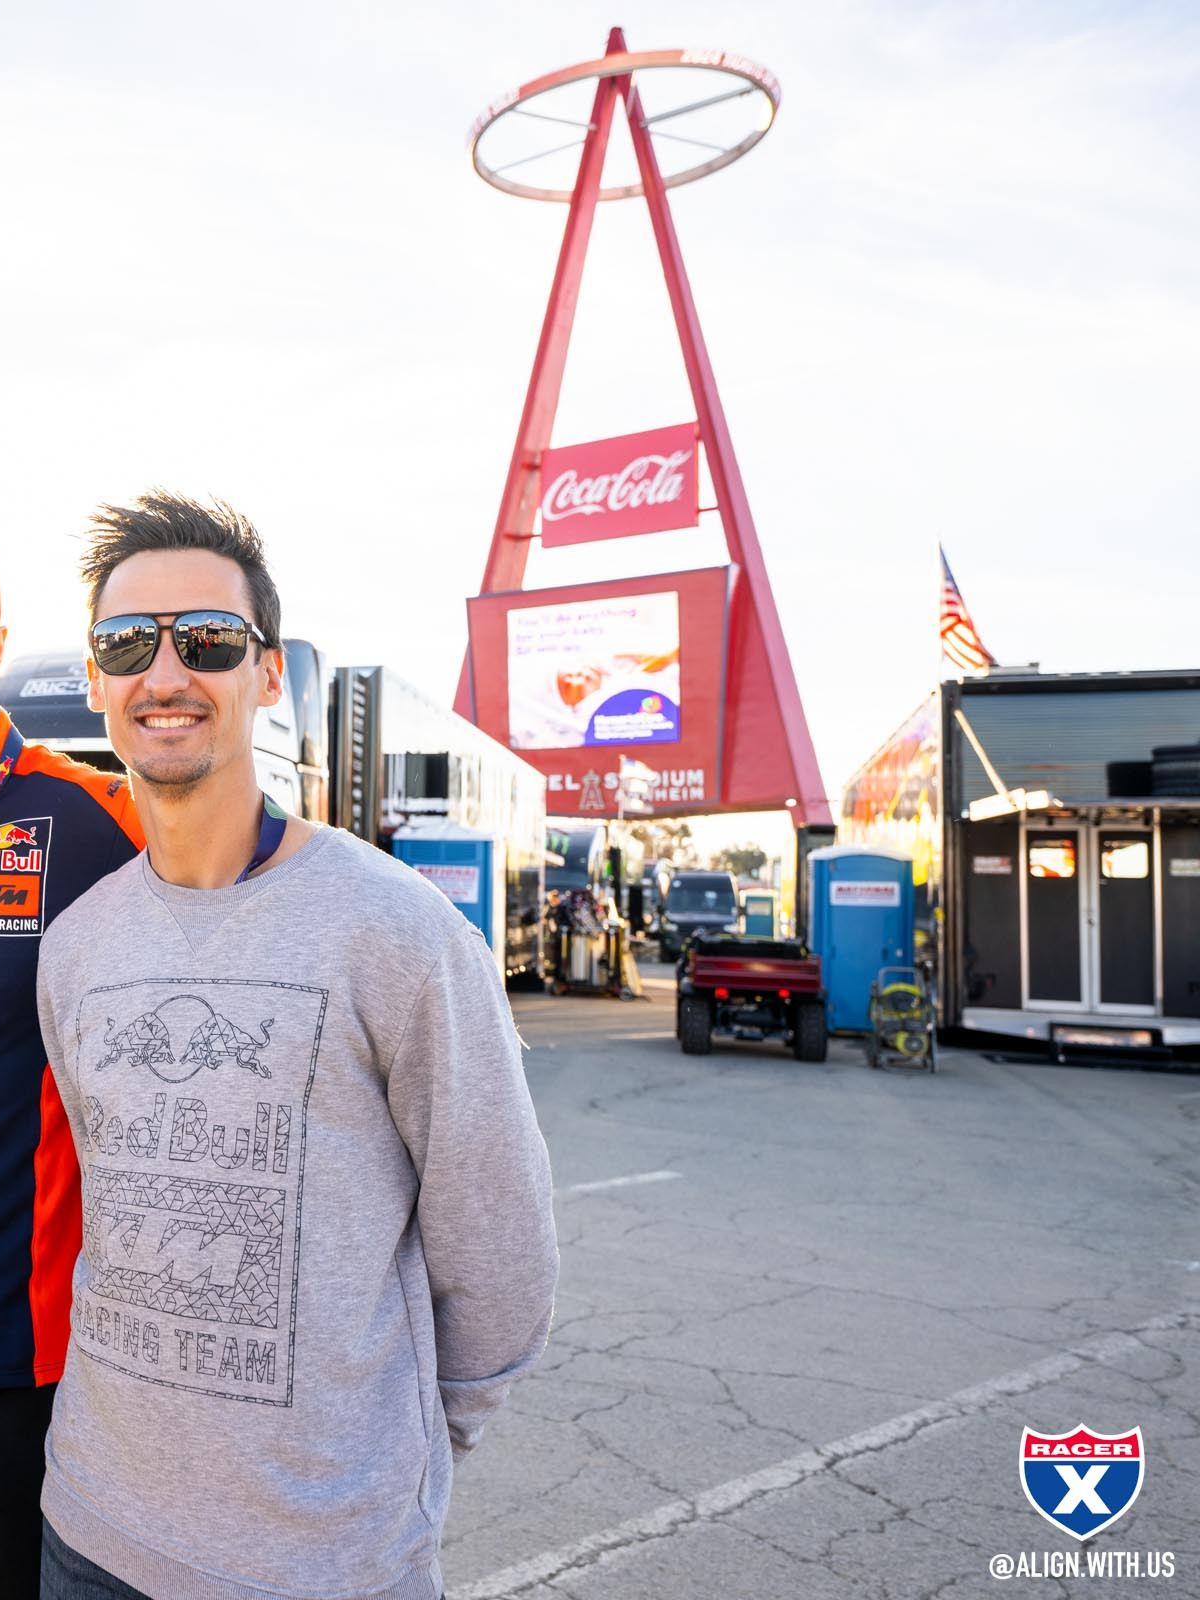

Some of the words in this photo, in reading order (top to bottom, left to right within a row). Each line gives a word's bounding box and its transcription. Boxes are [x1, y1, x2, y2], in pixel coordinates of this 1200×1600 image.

[542, 450, 694, 521] Coca-Cola
[1, 849, 42, 872] Bull
[0, 918, 39, 931] RACING
[84, 1092, 167, 1159] Red
[168, 1097, 292, 1175] Bull
[174, 1328, 277, 1385] TEAM
